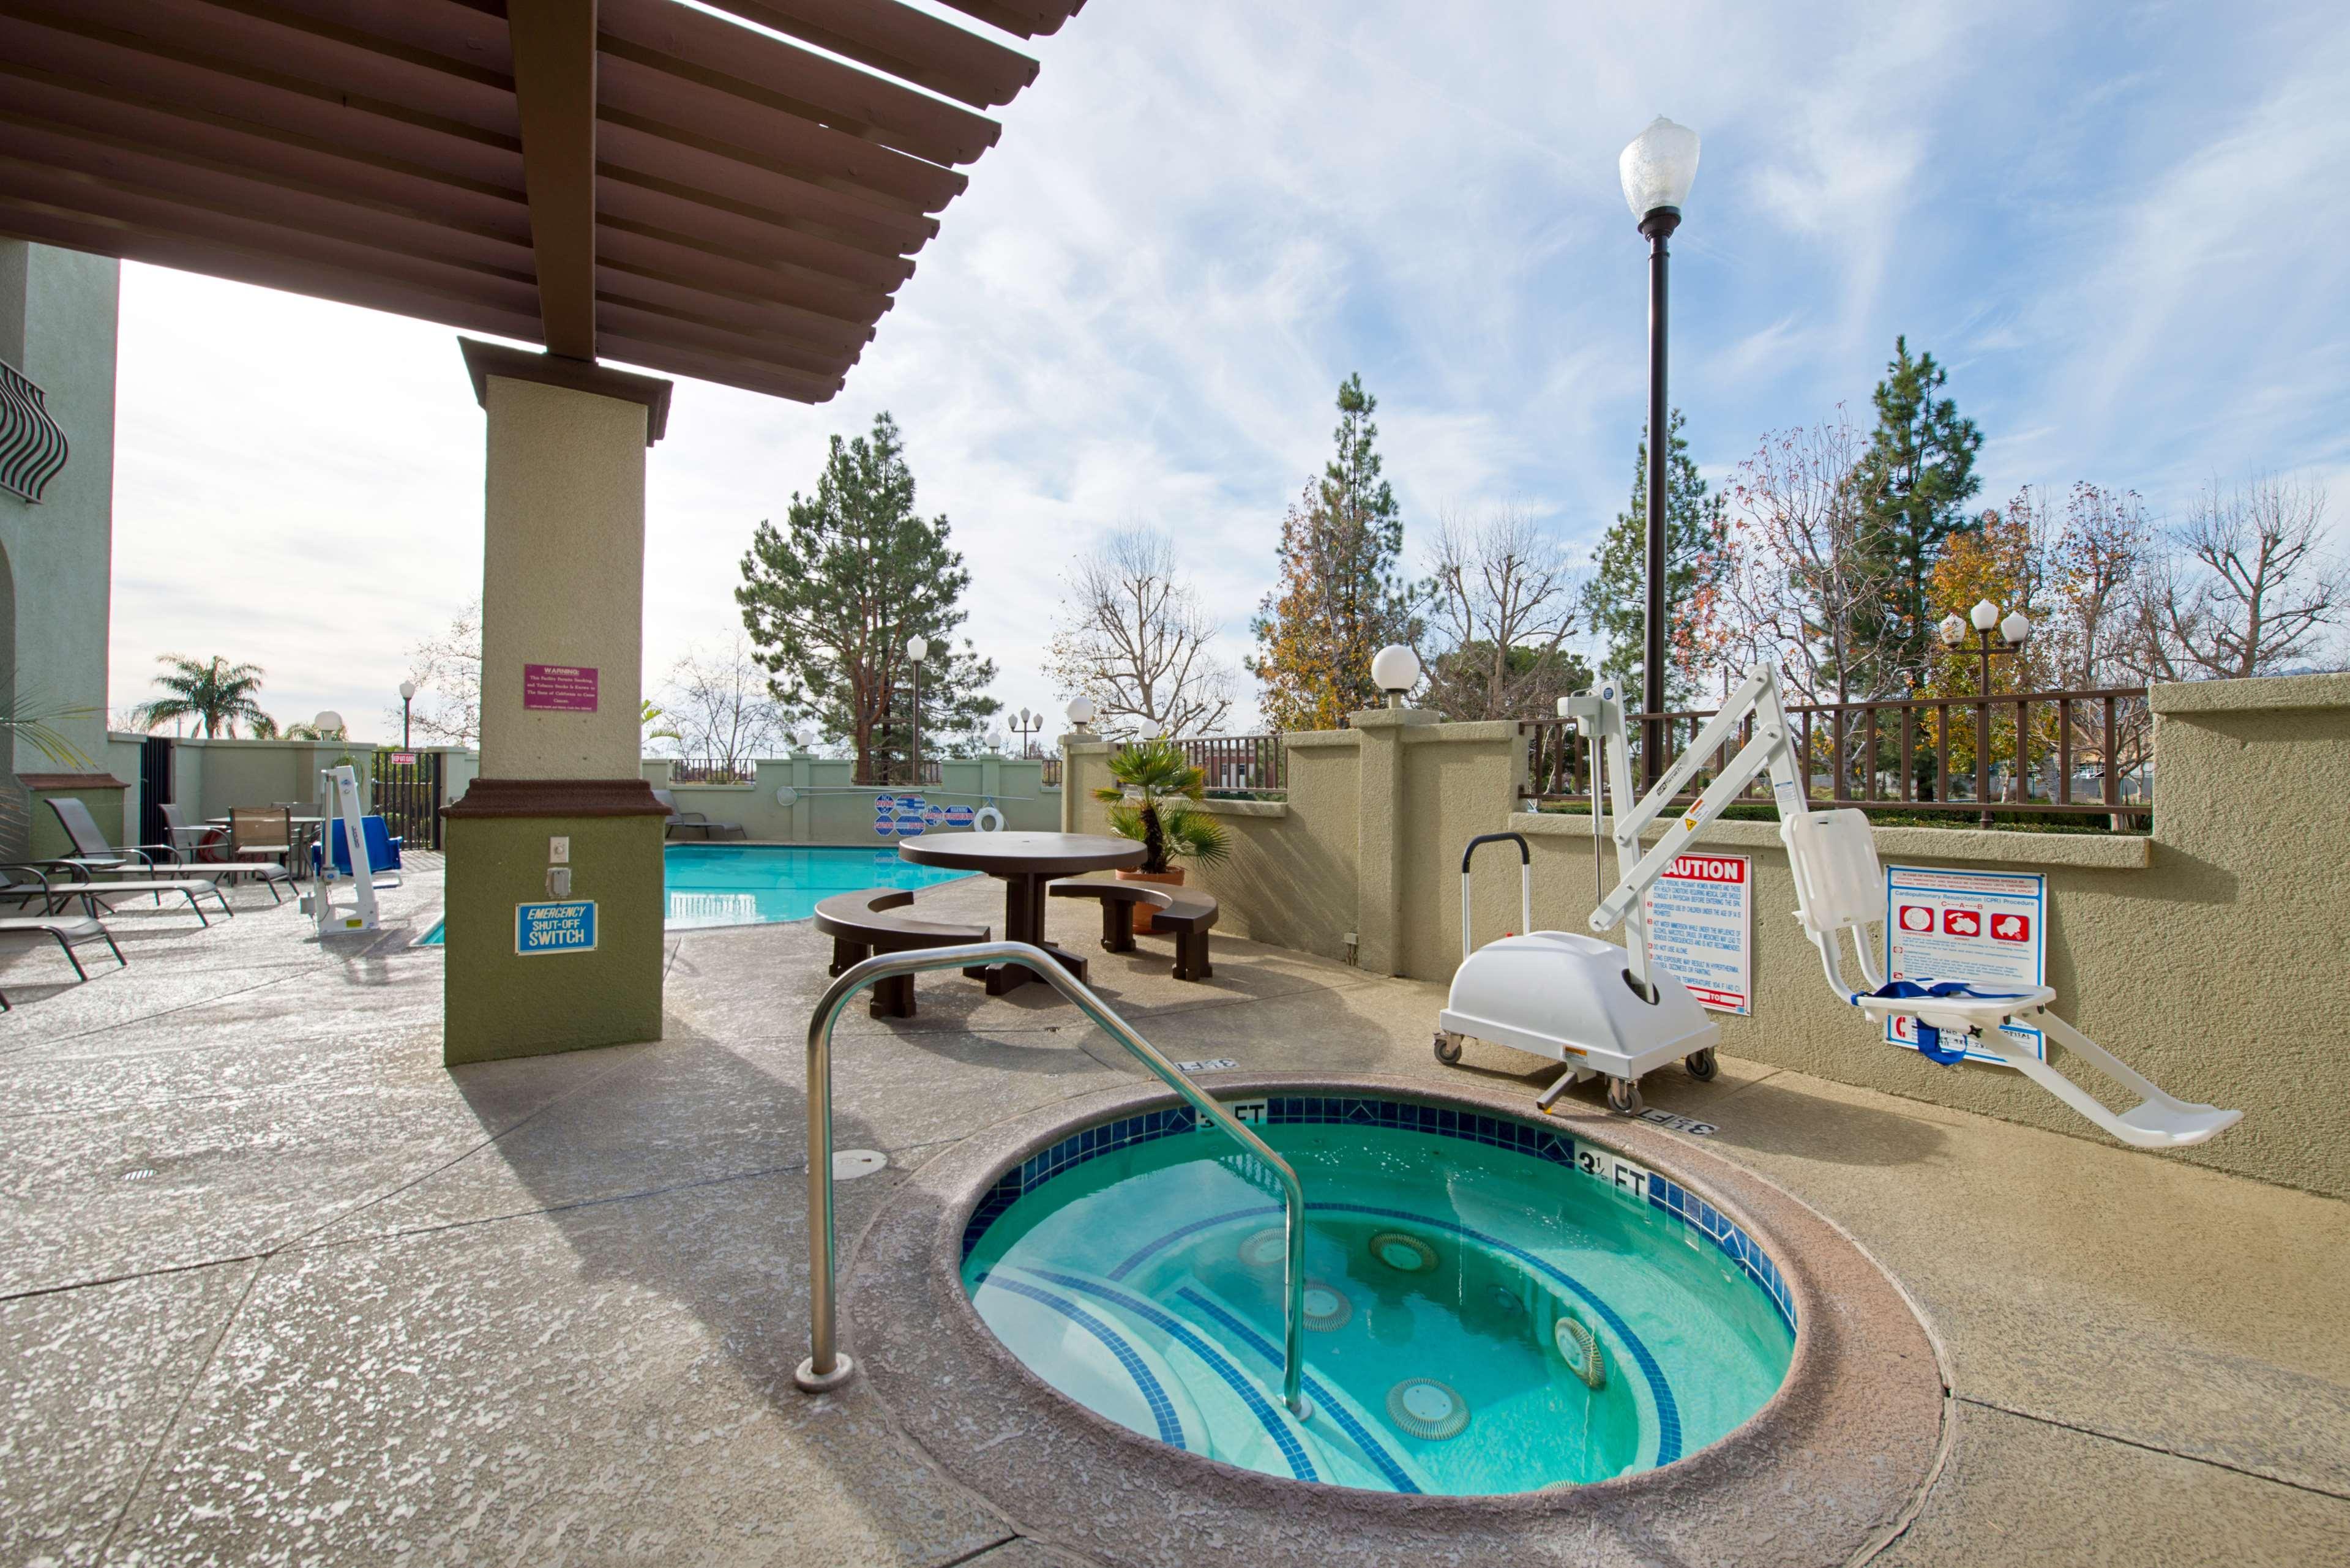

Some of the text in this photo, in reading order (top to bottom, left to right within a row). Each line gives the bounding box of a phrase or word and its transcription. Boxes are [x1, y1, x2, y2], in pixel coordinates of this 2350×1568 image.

[1665, 859, 1738, 879] AUTION
[1895, 890, 1941, 899] Cardiopulmonary
[527, 906, 586, 920] EMERGENCY
[533, 919, 580, 931] SHUT-OFF
[529, 929, 584, 946] SWITCH
[1668, 936, 1694, 944] CONSEQUENCES
[1683, 977, 1711, 987] TEMPERATURE
[1177, 1062, 1204, 1071] FT
[1636, 1109, 1675, 1124] FT
[1615, 1163, 1645, 1197] FT
